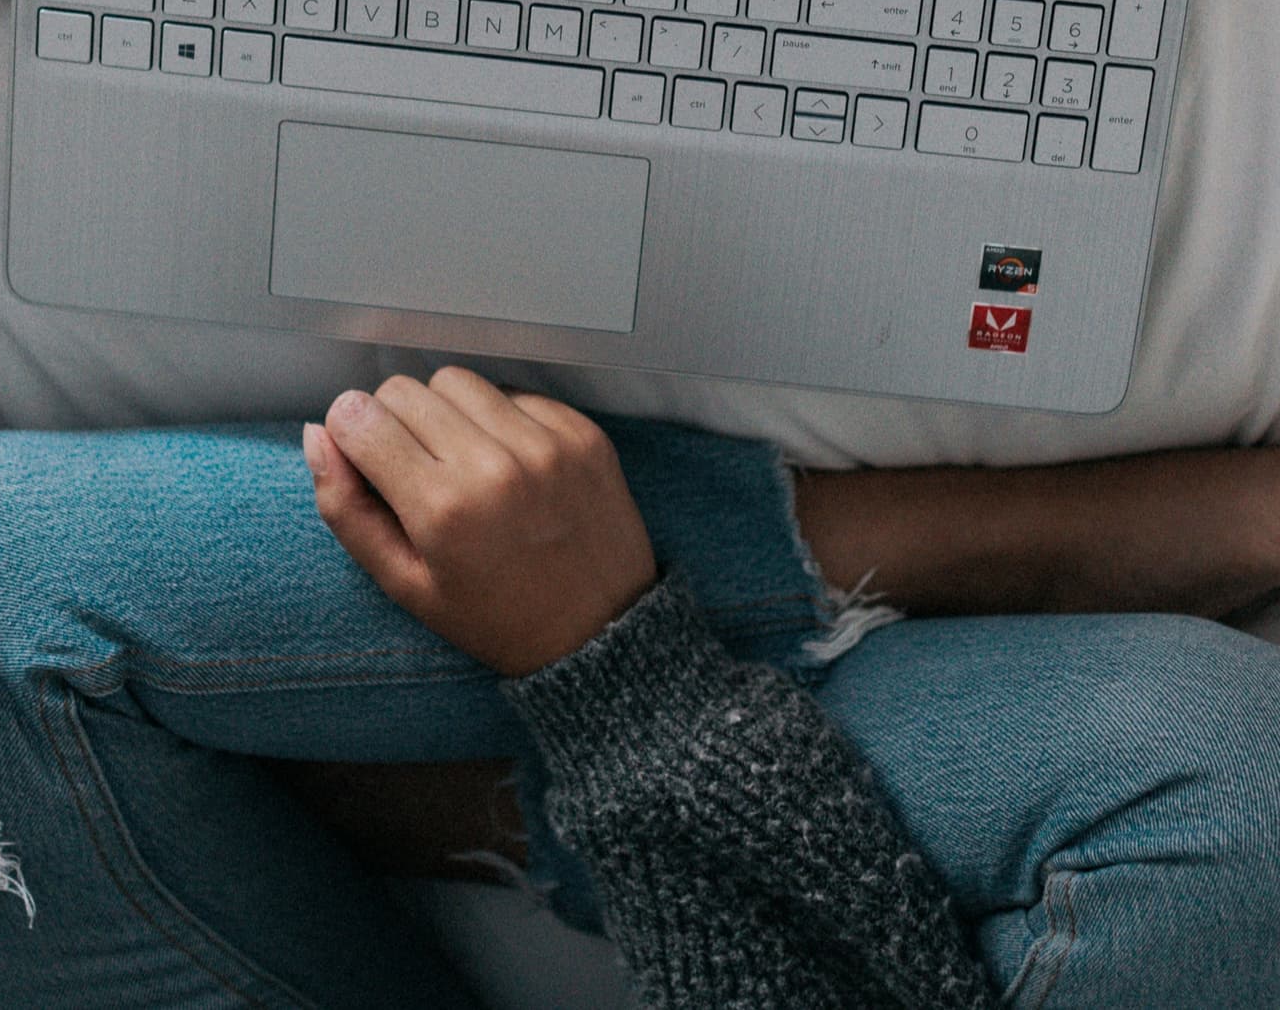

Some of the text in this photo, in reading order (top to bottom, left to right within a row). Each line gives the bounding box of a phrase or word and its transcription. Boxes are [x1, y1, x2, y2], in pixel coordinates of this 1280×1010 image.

[363, 4, 380, 22] V
[883, 7, 909, 15] enter
[424, 10, 439, 28] B
[485, 16, 502, 34] N
[545, 22, 563, 41] M
[782, 39, 810, 49] pause
[881, 62, 901, 72] shift
[631, 94, 643, 102] alt
[689, 100, 706, 108] ctrl
[1108, 116, 1134, 125] enter
[987, 263, 1032, 276] RYZEN
[976, 331, 1021, 340] RADEON
